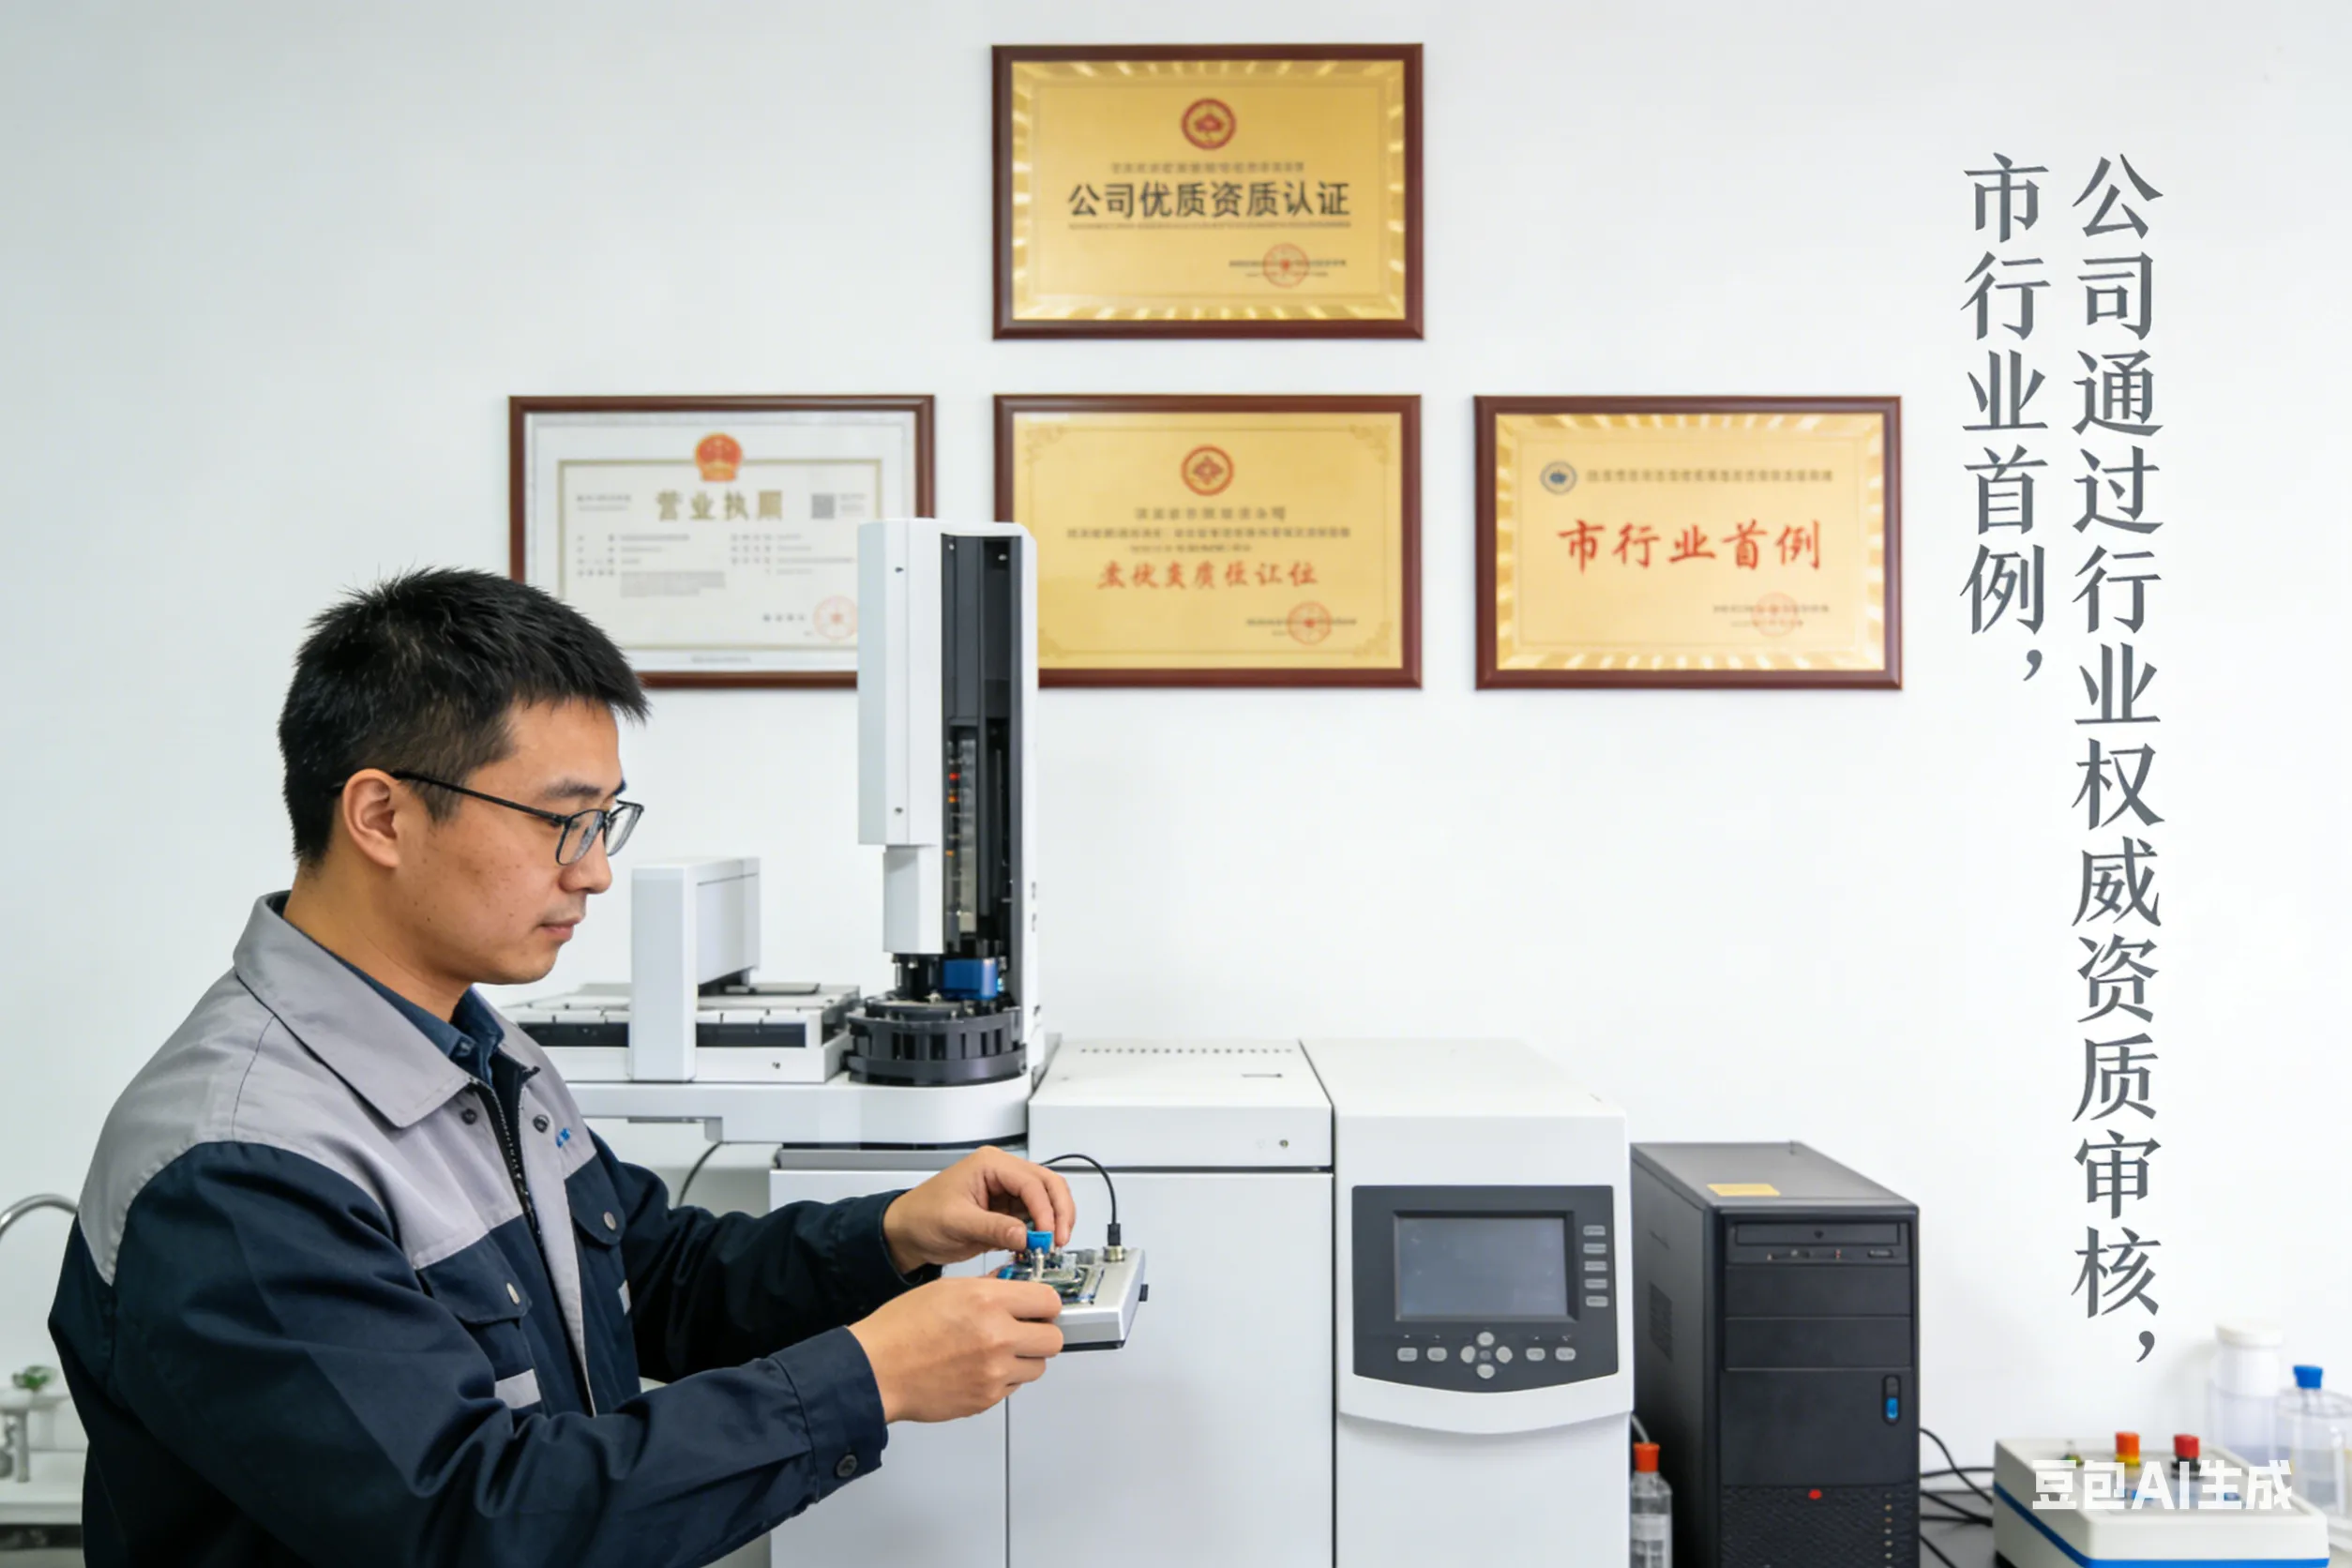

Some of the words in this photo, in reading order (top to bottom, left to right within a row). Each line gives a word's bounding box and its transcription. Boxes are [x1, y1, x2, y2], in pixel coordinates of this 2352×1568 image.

[1069, 181, 1349, 218] 公司优质资质认证
[1558, 519, 1822, 575] 市行业首例
